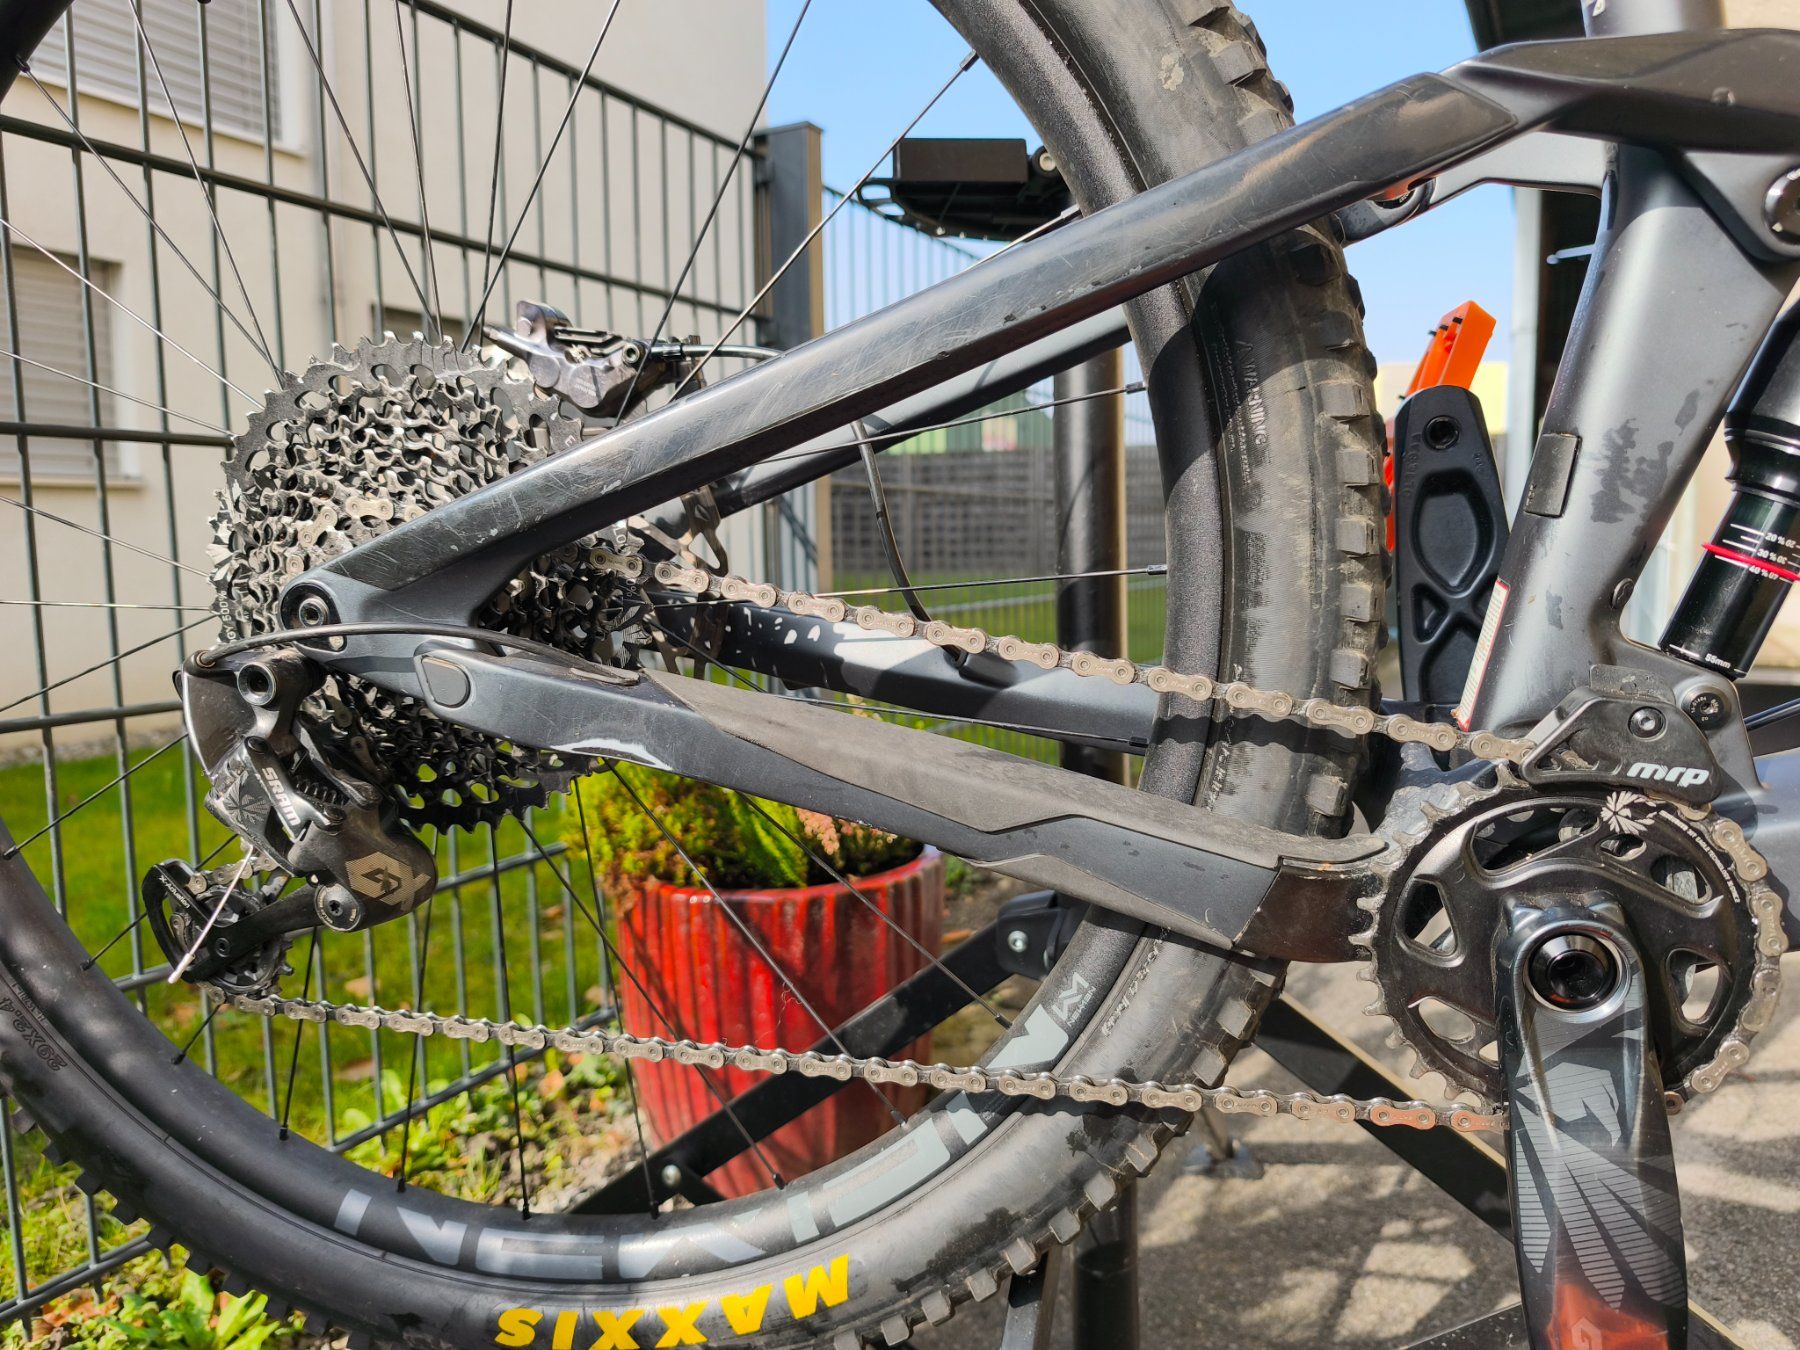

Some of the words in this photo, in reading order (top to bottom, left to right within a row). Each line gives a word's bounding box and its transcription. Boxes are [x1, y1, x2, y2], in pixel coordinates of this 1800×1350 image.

[261, 766, 301, 827] SRAM
[1627, 761, 1710, 788] mrp
[494, 1254, 850, 1350] MAXXIS
